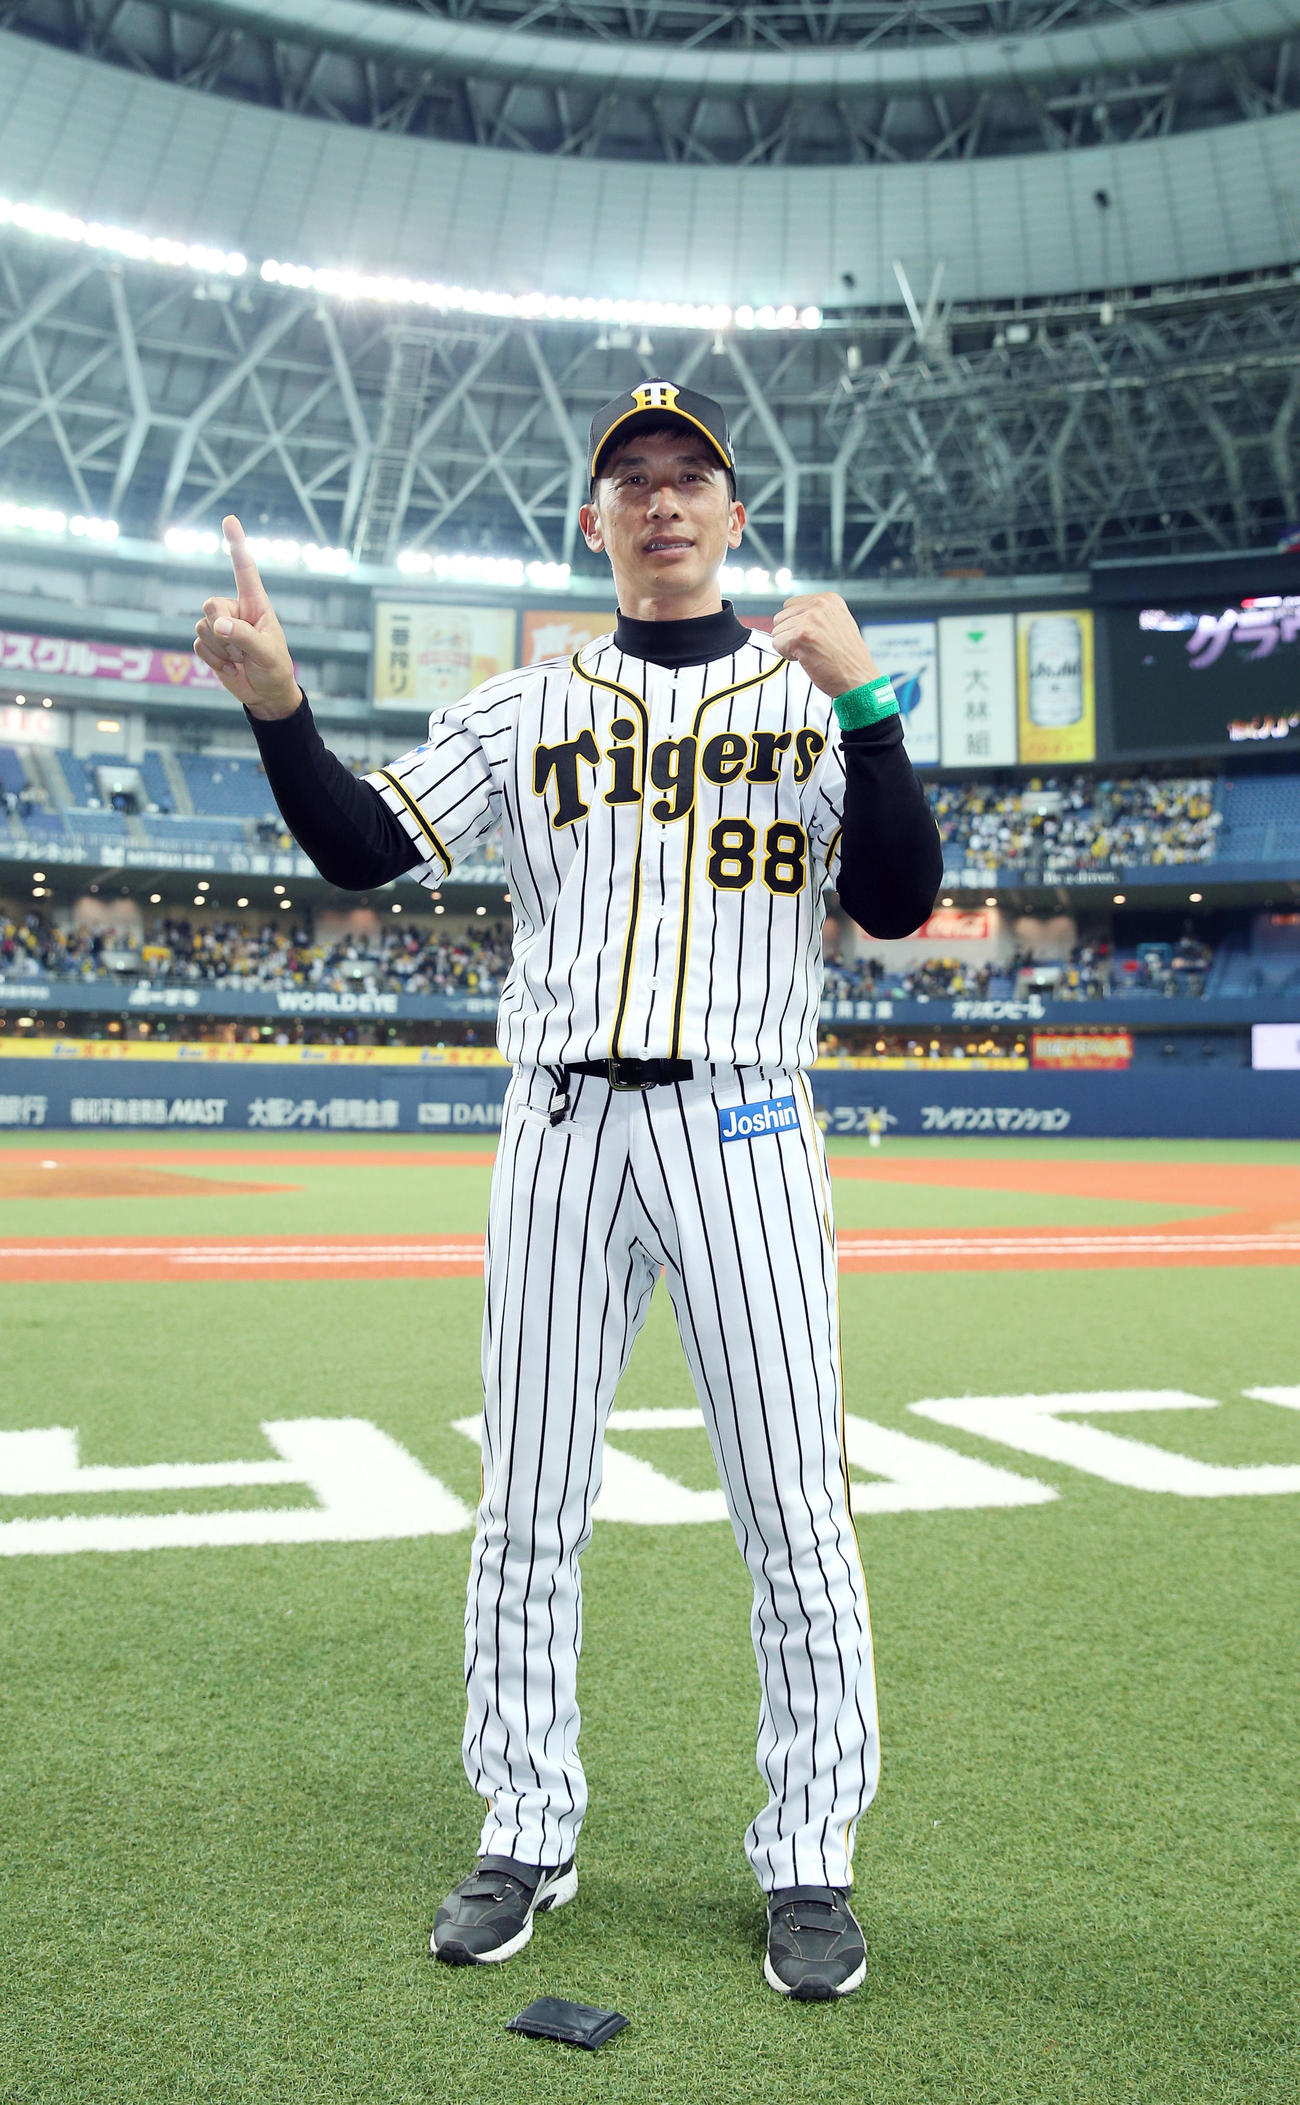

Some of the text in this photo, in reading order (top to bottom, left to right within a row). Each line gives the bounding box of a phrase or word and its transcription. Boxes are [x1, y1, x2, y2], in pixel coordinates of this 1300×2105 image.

[964, 667, 991, 756] 大林組
[533, 719, 825, 830] Tigers
[706, 817, 806, 897] 88
[723, 1102, 798, 1137] Joshin
